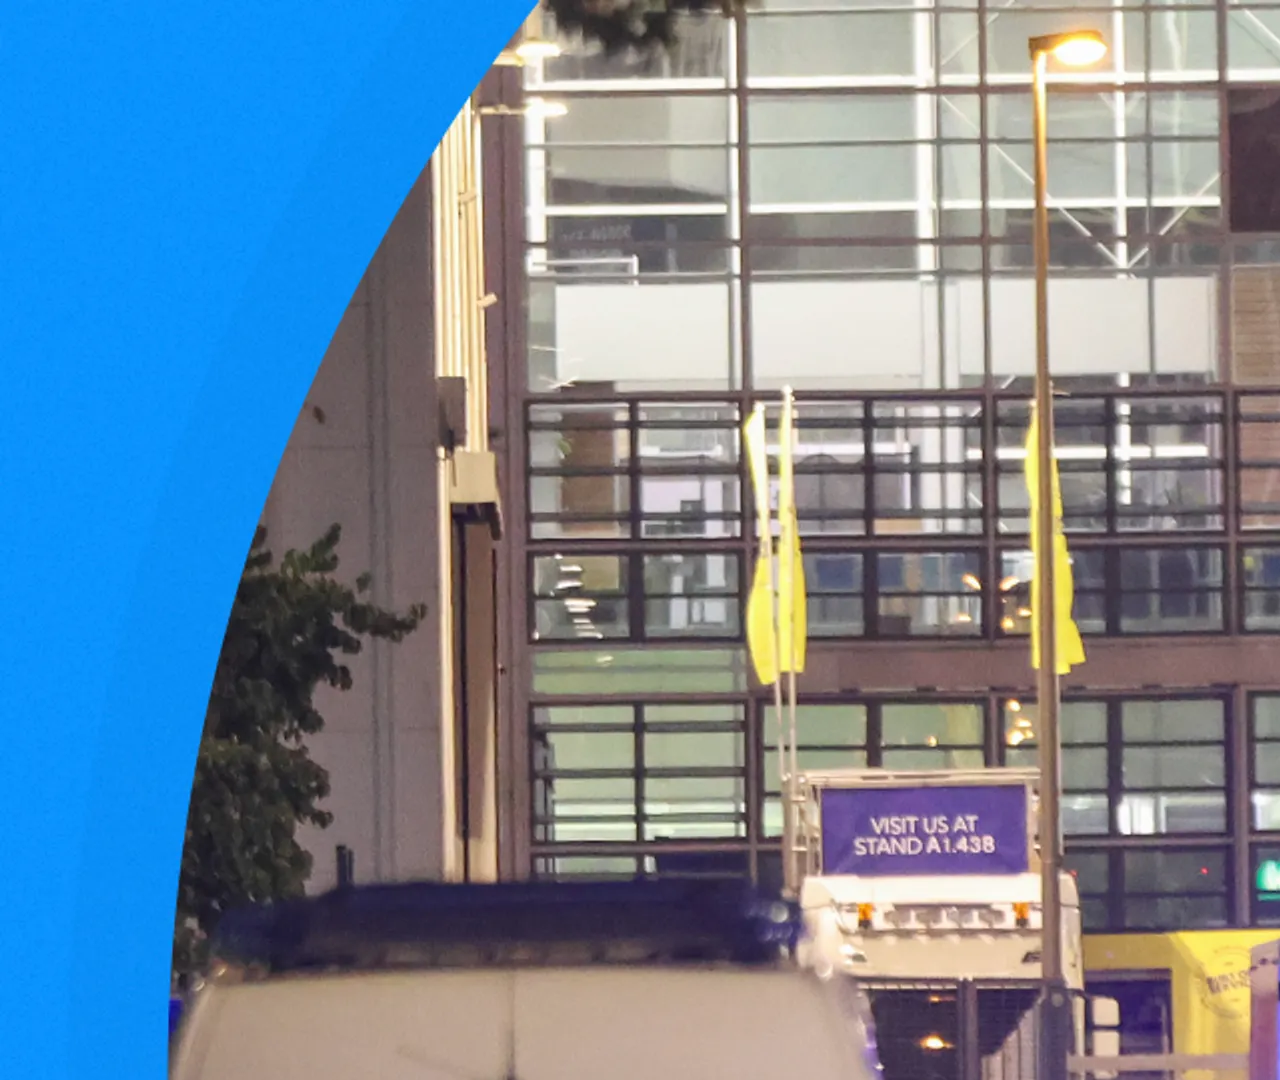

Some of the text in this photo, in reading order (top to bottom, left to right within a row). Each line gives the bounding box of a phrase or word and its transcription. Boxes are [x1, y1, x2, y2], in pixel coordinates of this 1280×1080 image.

[870, 814, 979, 836] VISIT US AT
[854, 836, 922, 856] STAND
